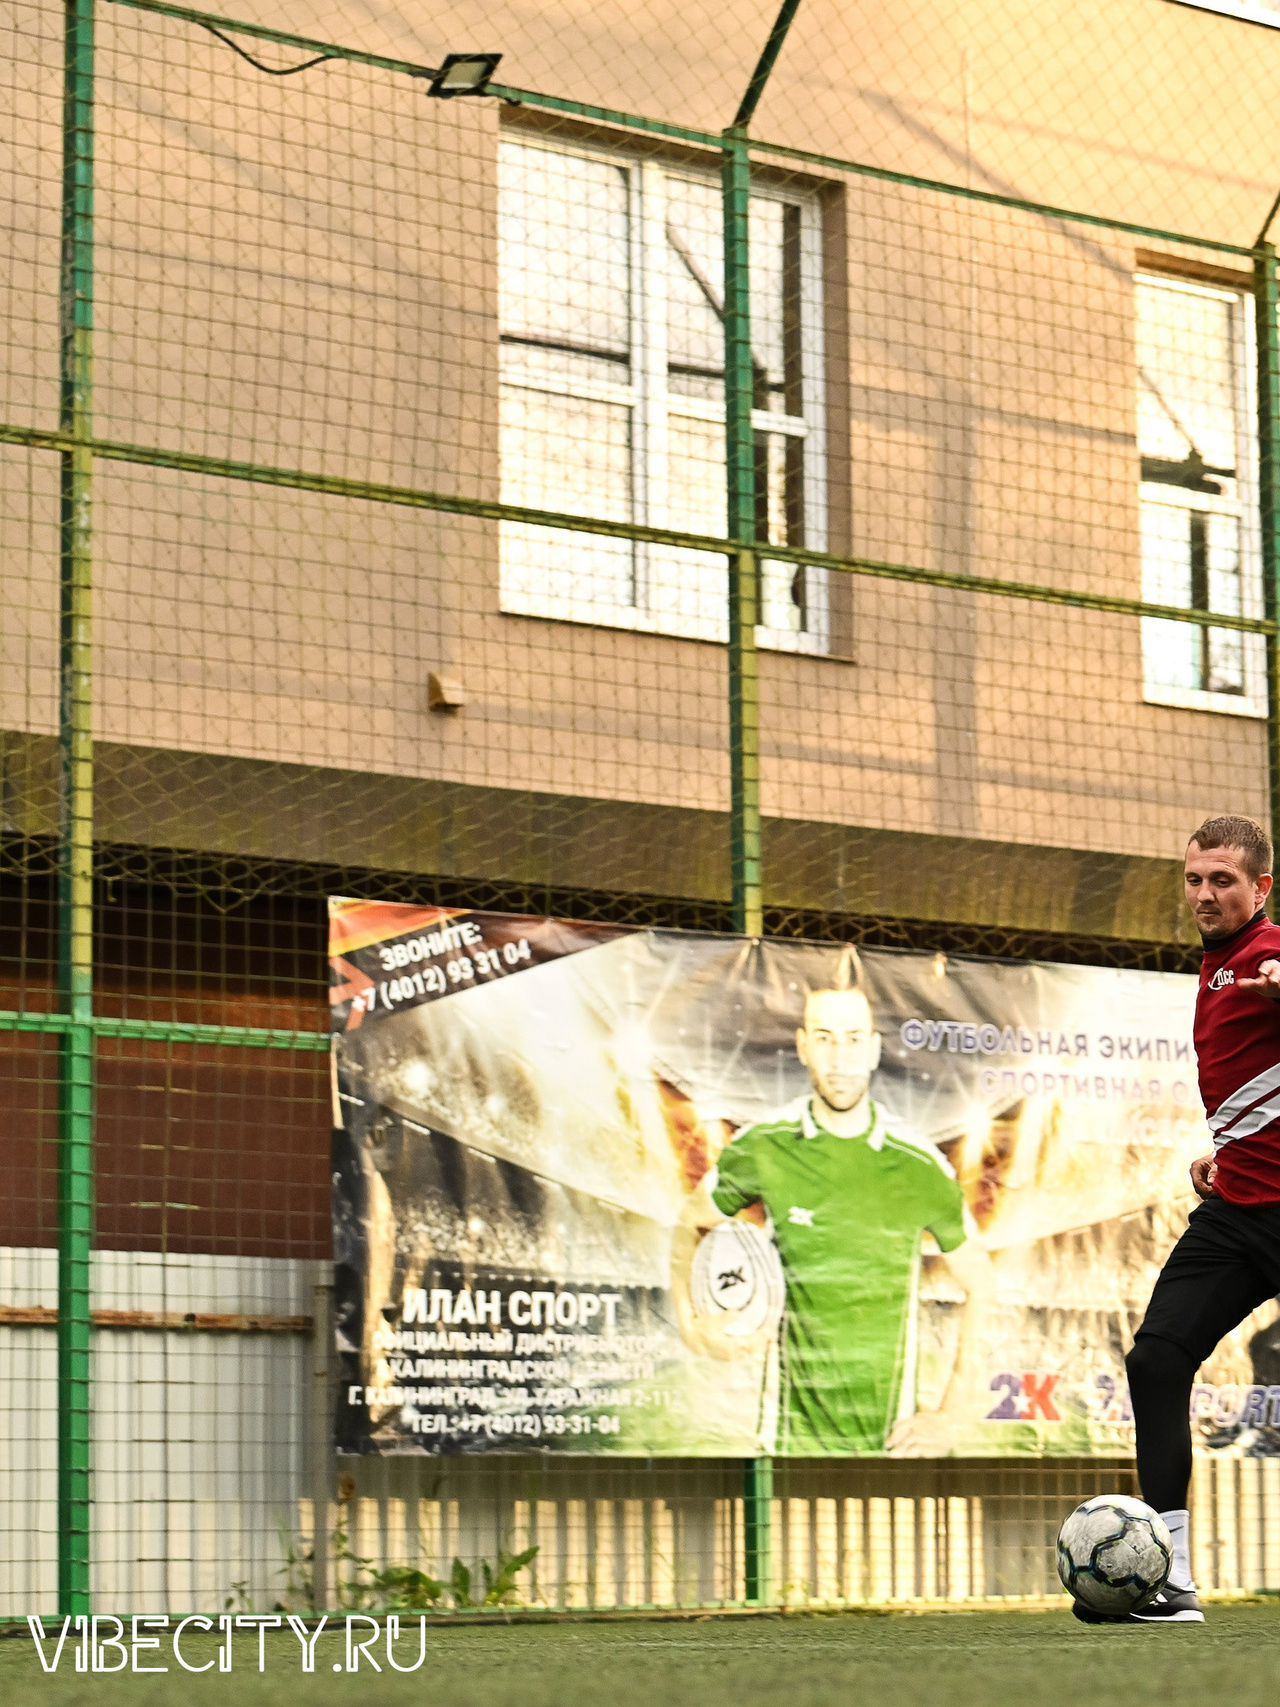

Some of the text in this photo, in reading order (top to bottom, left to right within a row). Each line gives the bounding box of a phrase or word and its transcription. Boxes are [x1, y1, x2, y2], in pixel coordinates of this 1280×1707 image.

[379, 921, 482, 972] ЗВОНИТЕ:
[380, 965, 447, 1010] (4012)
[449, 958, 475, 984] 93
[476, 948, 501, 973] 31
[503, 938, 532, 966] 04
[900, 1018, 1194, 1063] ФУТБОЛЬНАЯ ЭКИПИ
[978, 1066, 1163, 1104] СПОРТИВНАЯ
[402, 1288, 622, 1327] ИЛАН СПОРТ
[984, 1373, 1062, 1421] 2K
[543, 1414, 621, 1435] 93-31-04
